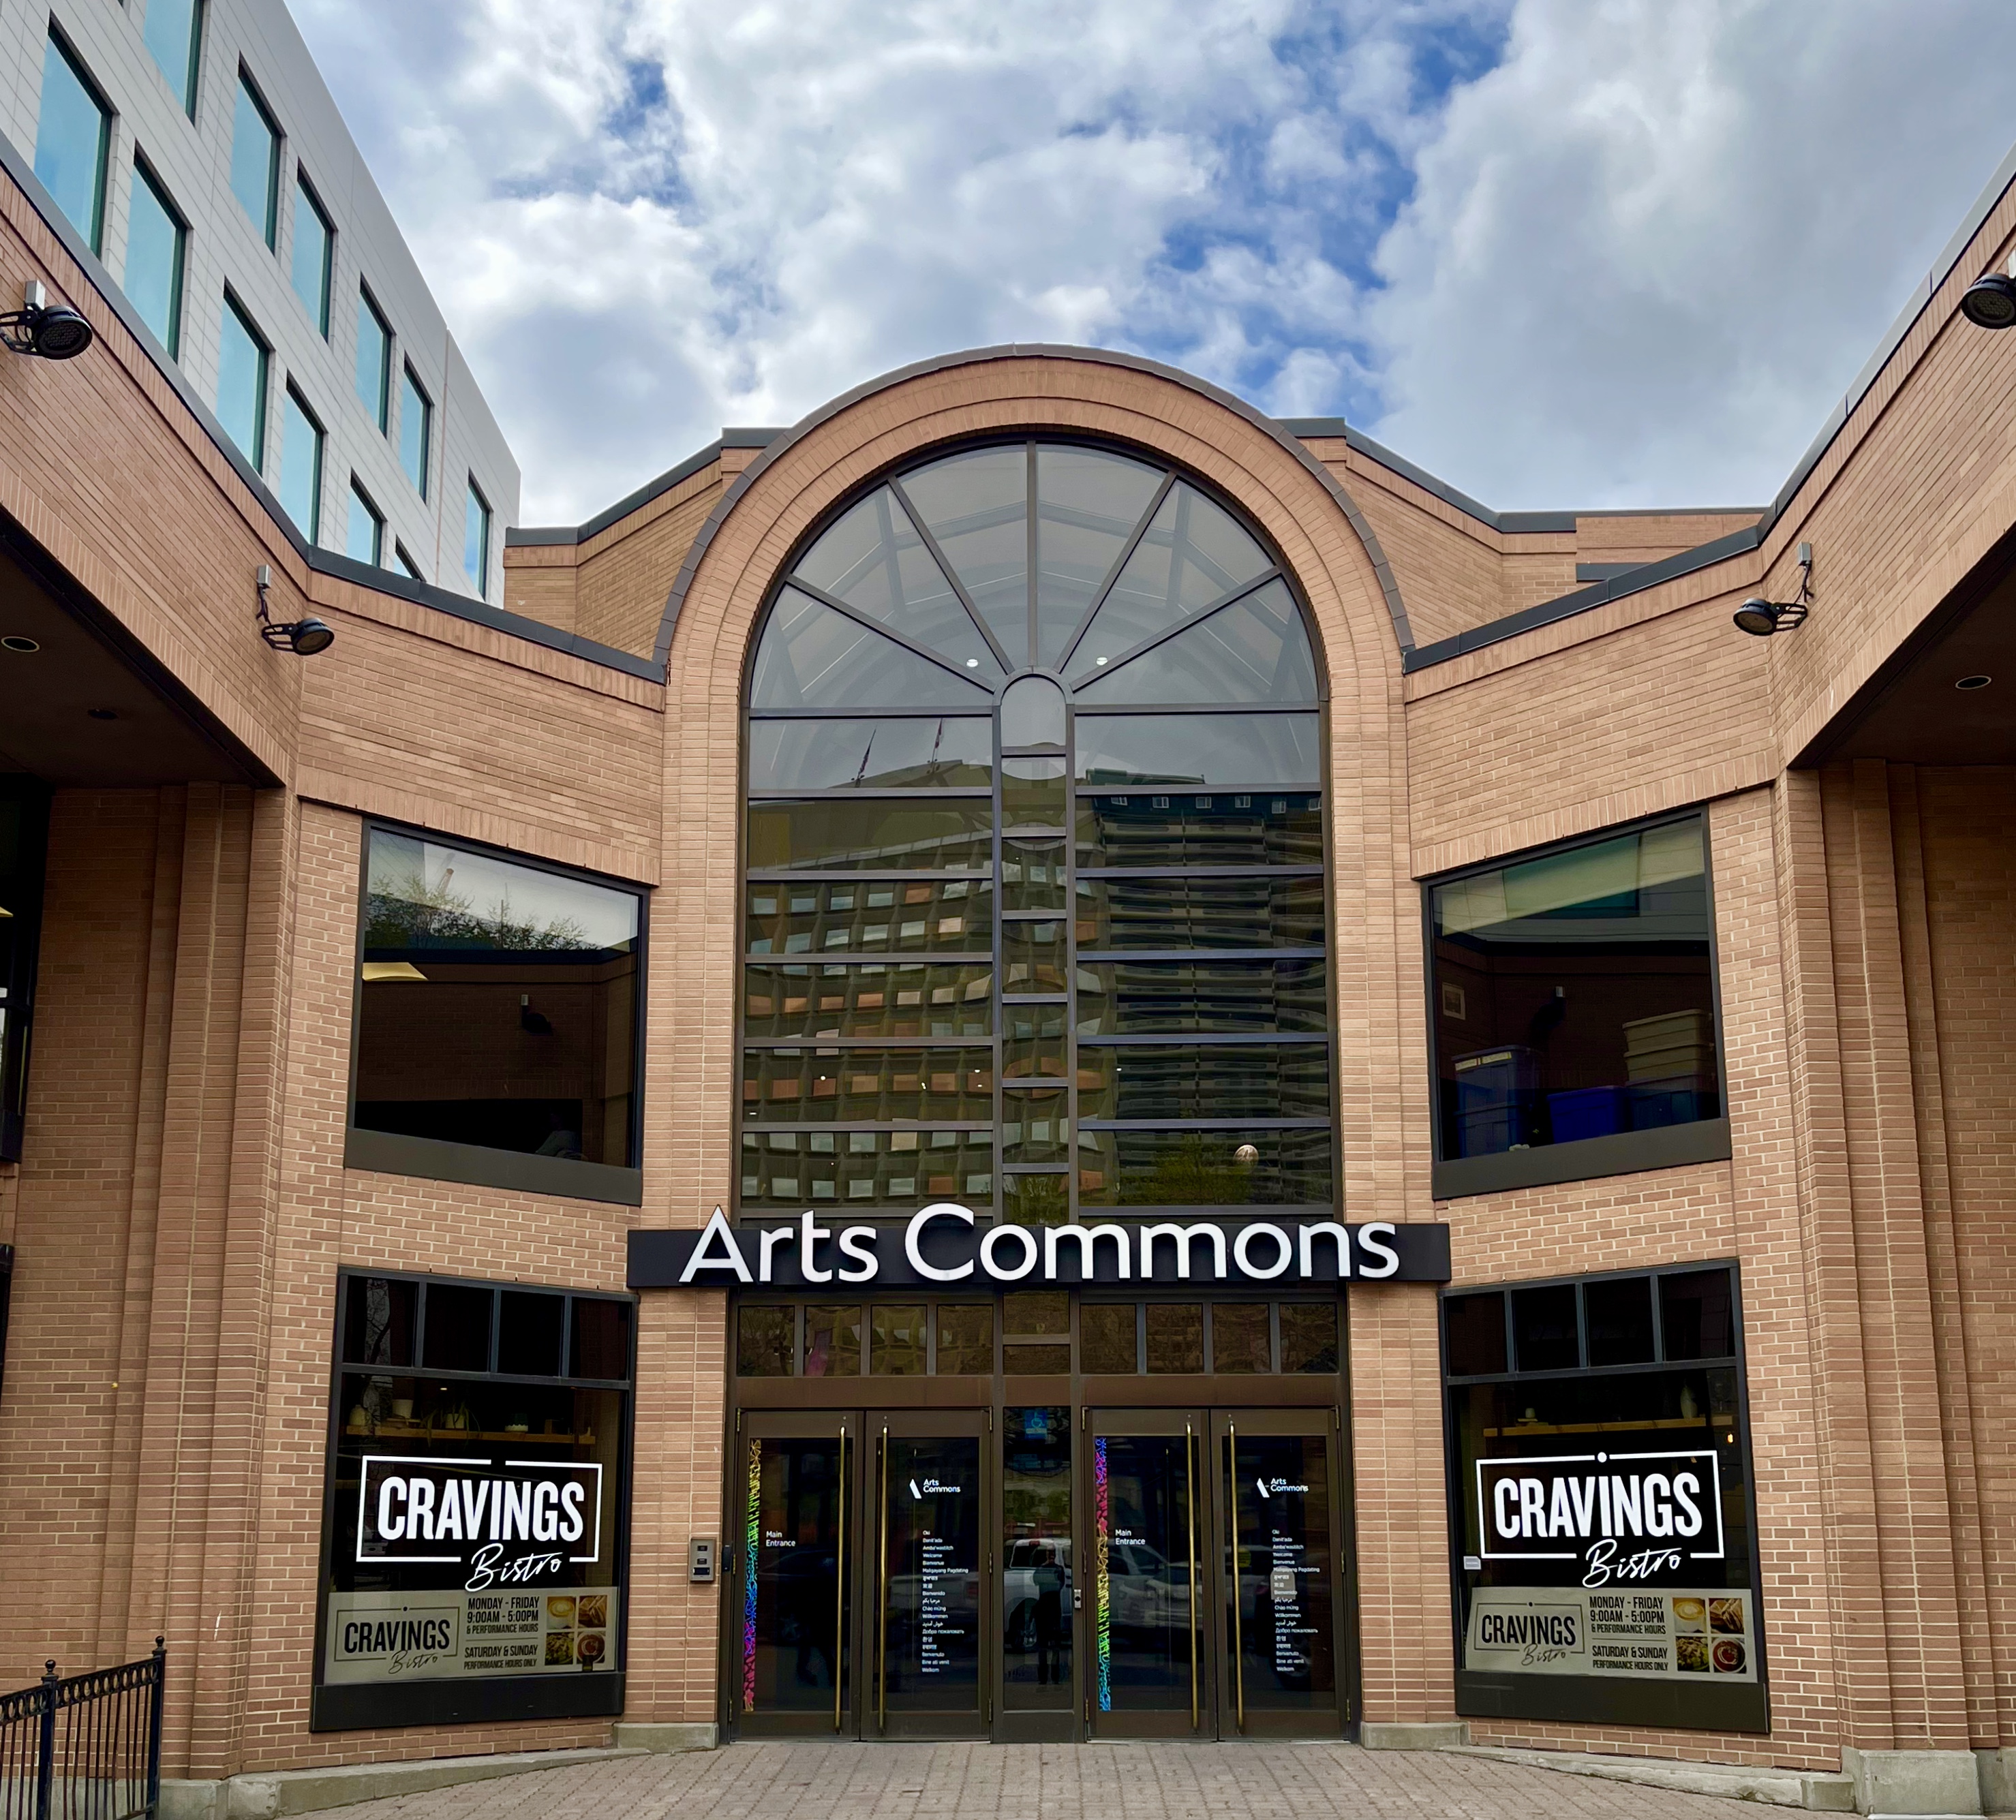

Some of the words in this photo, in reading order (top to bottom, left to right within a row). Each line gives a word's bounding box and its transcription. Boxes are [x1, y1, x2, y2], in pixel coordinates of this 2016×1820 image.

[679, 1204, 877, 1282] Arts
[904, 1203, 1399, 1280] Commons
[1270, 1484, 1309, 1492] Commons
[378, 1476, 584, 1541] CRAVINGS
[1494, 1472, 1702, 1538] CRAVINGS
[1115, 1537, 1146, 1545] Entrance
[465, 1543, 563, 1592] Bistro
[1583, 1539, 1682, 1588] Bistro
[468, 1597, 503, 1610] MONDAY
[511, 1597, 540, 1609] FRIDAY
[1589, 1597, 1625, 1609] MONDAY
[1633, 1597, 1663, 1609] FRIDAY
[467, 1611, 500, 1623] 9:00AM
[508, 1610, 538, 1622] 5:00PM
[1590, 1610, 1623, 1622] 9:00AM
[1631, 1611, 1664, 1623] 5:00PM
[344, 1619, 450, 1652] CRAVINGS
[466, 1625, 471, 1634] &
[472, 1624, 517, 1634] PERFORMANCE
[519, 1624, 538, 1633] HOURS
[1482, 1614, 1576, 1646] CRAVINGS
[1591, 1624, 1595, 1633] &
[1597, 1624, 1643, 1634] PERFORMANCE
[1645, 1625, 1666, 1635] HOURS
[465, 1646, 502, 1658] SATURDAY
[504, 1646, 508, 1656] &
[510, 1645, 538, 1656] SUNDAY
[1521, 1644, 1566, 1666] Bistro
[1592, 1646, 1629, 1658] SATURDAY
[1631, 1647, 1636, 1658] &
[1638, 1647, 1668, 1659] SUNDAY
[388, 1650, 438, 1674] Bistro
[464, 1660, 504, 1669] PERFORMANCE
[505, 1659, 523, 1667] HOURS
[523, 1659, 537, 1667] ONLY
[1593, 1660, 1633, 1669] PERFORMANCE
[1634, 1661, 1653, 1670] HOURS
[1654, 1662, 1668, 1671] ONLY
